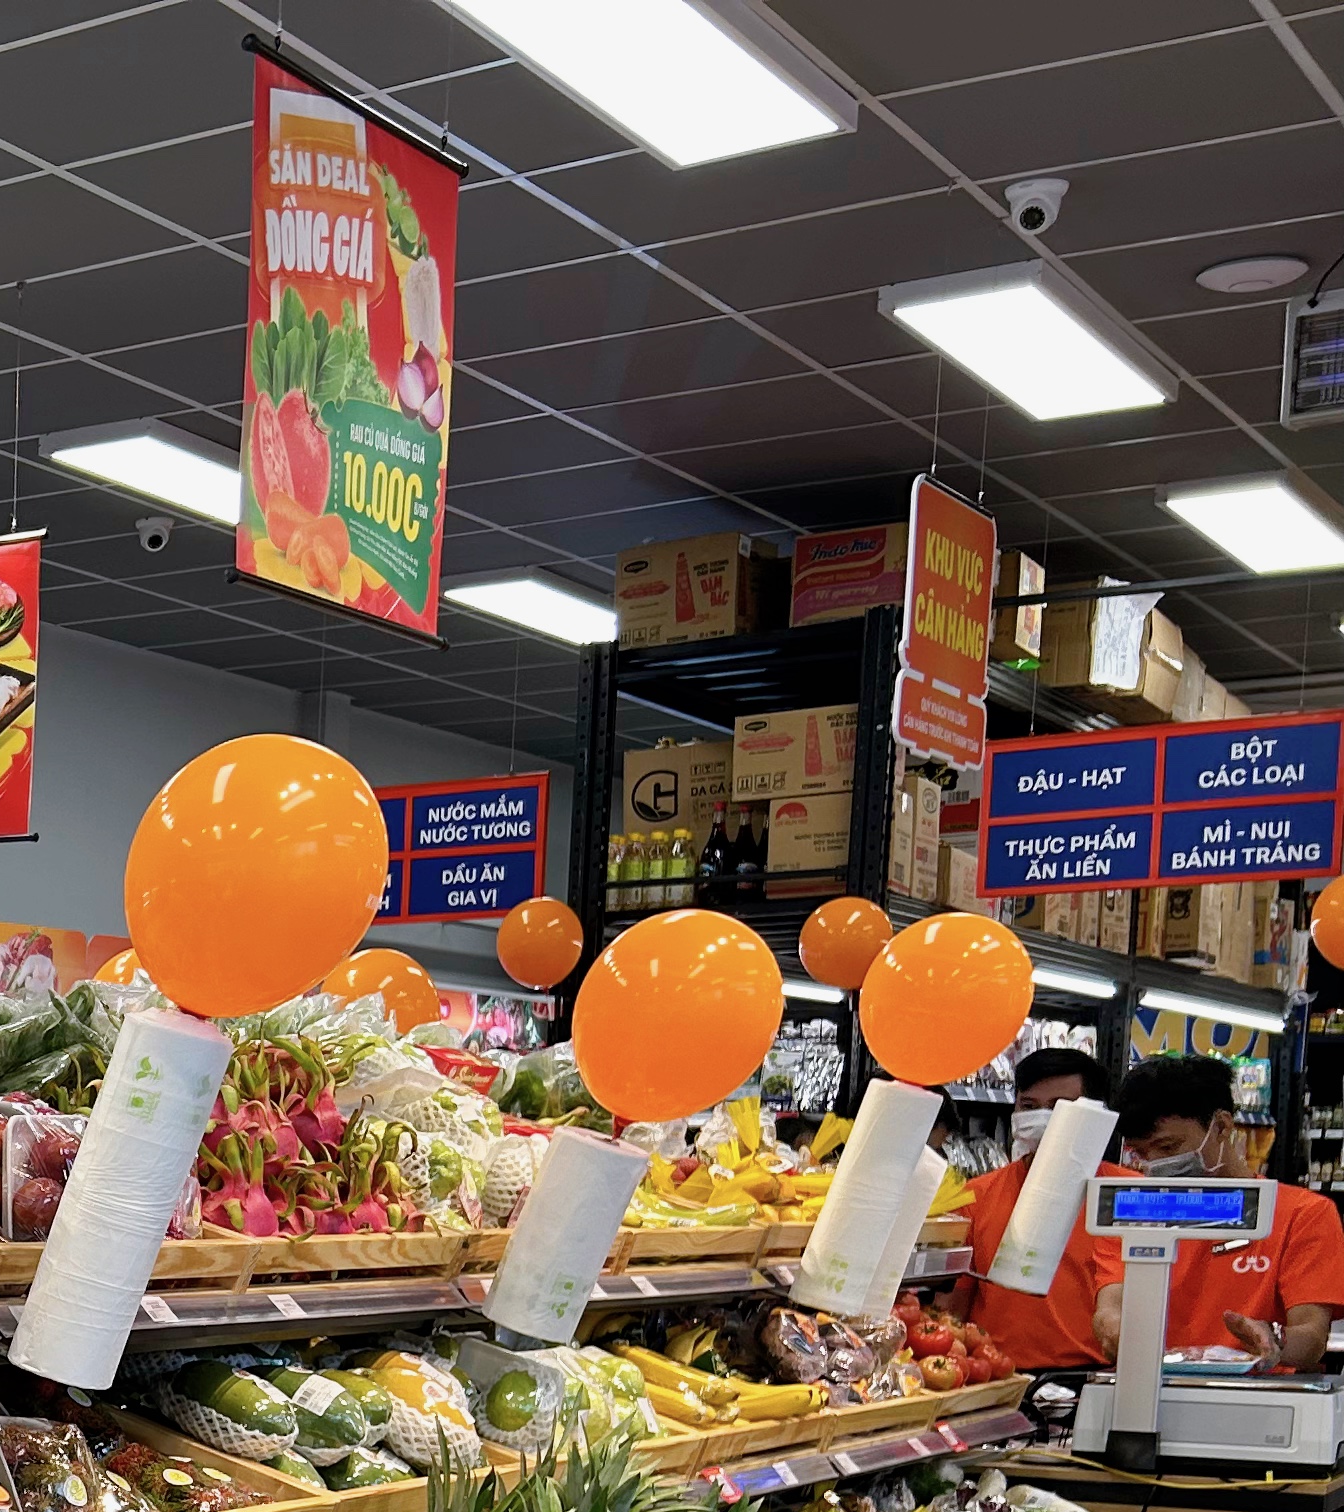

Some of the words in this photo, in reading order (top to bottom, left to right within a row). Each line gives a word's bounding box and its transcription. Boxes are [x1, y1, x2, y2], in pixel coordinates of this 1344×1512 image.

[316, 152, 370, 197] DEAL
[265, 194, 330, 273] ĐỒNG
[333, 207, 374, 283] GIÁ
[350, 423, 364, 444] RAU
[364, 422, 374, 447] CỦ
[374, 428, 389, 453] QUẢ
[412, 442, 425, 465] GIÁ
[925, 527, 955, 581] KHU
[956, 546, 984, 604] VỰC
[914, 587, 945, 645] CÂN
[946, 605, 985, 663] HÀNG
[1230, 735, 1277, 764] BỘT
[1018, 768, 1064, 797] ĐẬU
[1082, 766, 1126, 791] HẠT
[1198, 764, 1247, 789] CÁC
[1252, 763, 1305, 787] LOẠI
[427, 800, 477, 824] NƯỚC
[480, 793, 524, 818] MẮM
[419, 821, 468, 845] NƯỚC
[471, 820, 531, 841] TƯƠNG
[1005, 836, 1067, 862] THỰC
[1070, 823, 1137, 852] PHẨM
[1203, 818, 1232, 843] MÌ
[1252, 820, 1291, 841] NUI
[1025, 858, 1060, 881] ĂN
[1063, 853, 1111, 877] LIỀN
[1171, 848, 1236, 870] BÁNH
[1241, 839, 1321, 864] TRÁNG
[441, 863, 477, 885] DẦU
[480, 862, 505, 882] ĂN
[447, 889, 477, 907] GIA
[482, 888, 498, 908] VỊ
